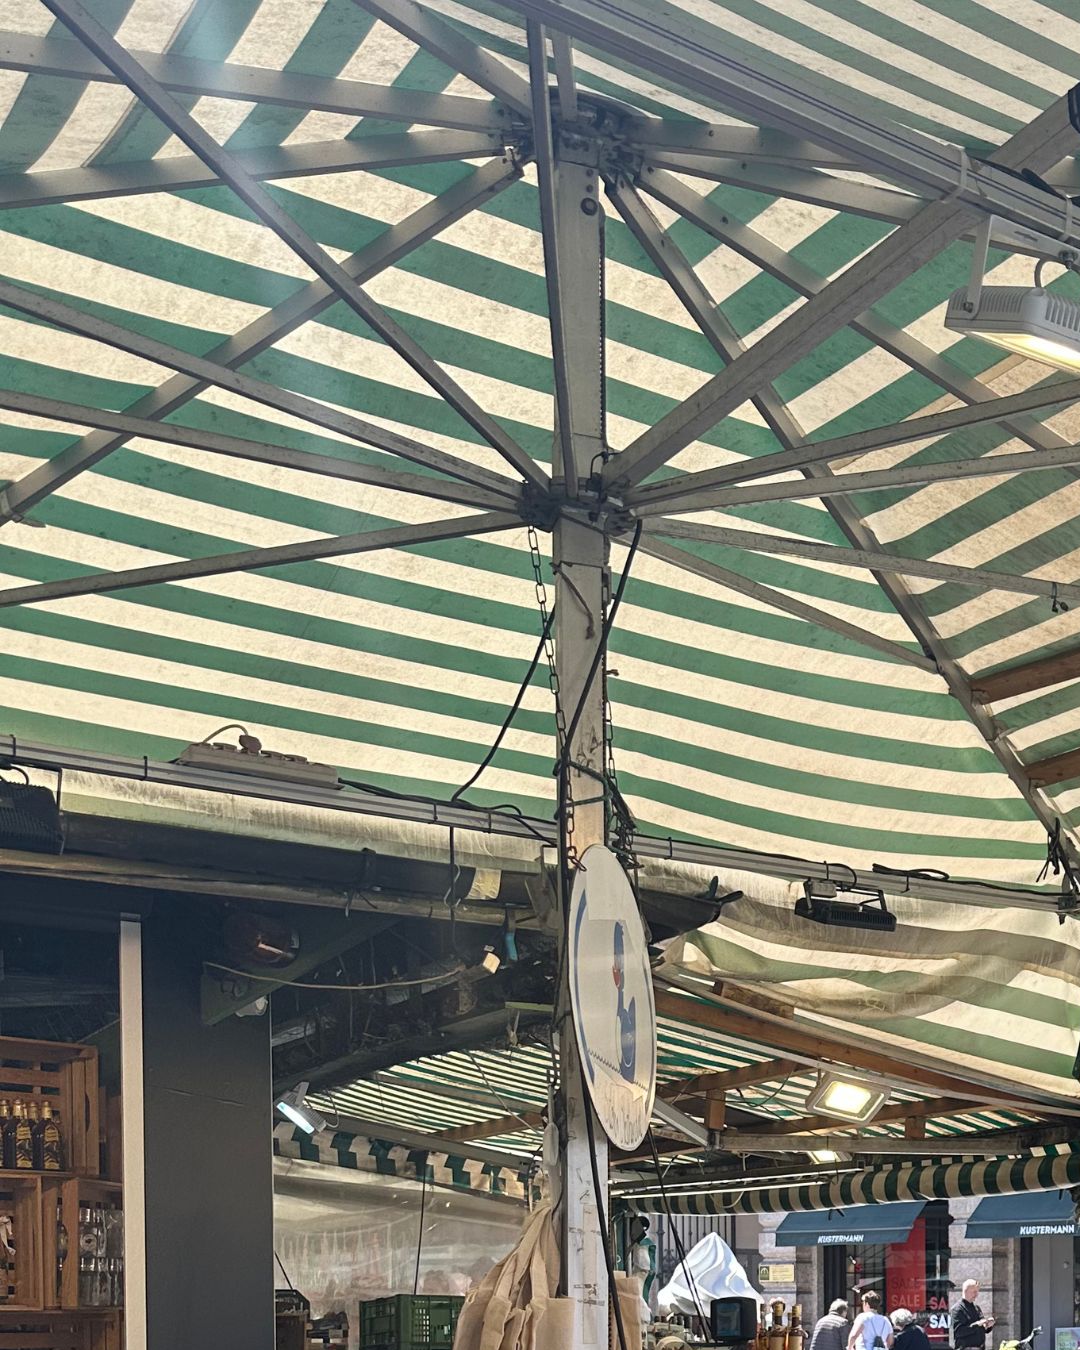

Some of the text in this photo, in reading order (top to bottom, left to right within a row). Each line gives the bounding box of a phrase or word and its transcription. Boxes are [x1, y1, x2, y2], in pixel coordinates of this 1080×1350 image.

[1020, 1225, 1075, 1235] KUSTERMANN
[817, 1234, 864, 1244] KUSTERMANN
[891, 1294, 920, 1307] SALE
